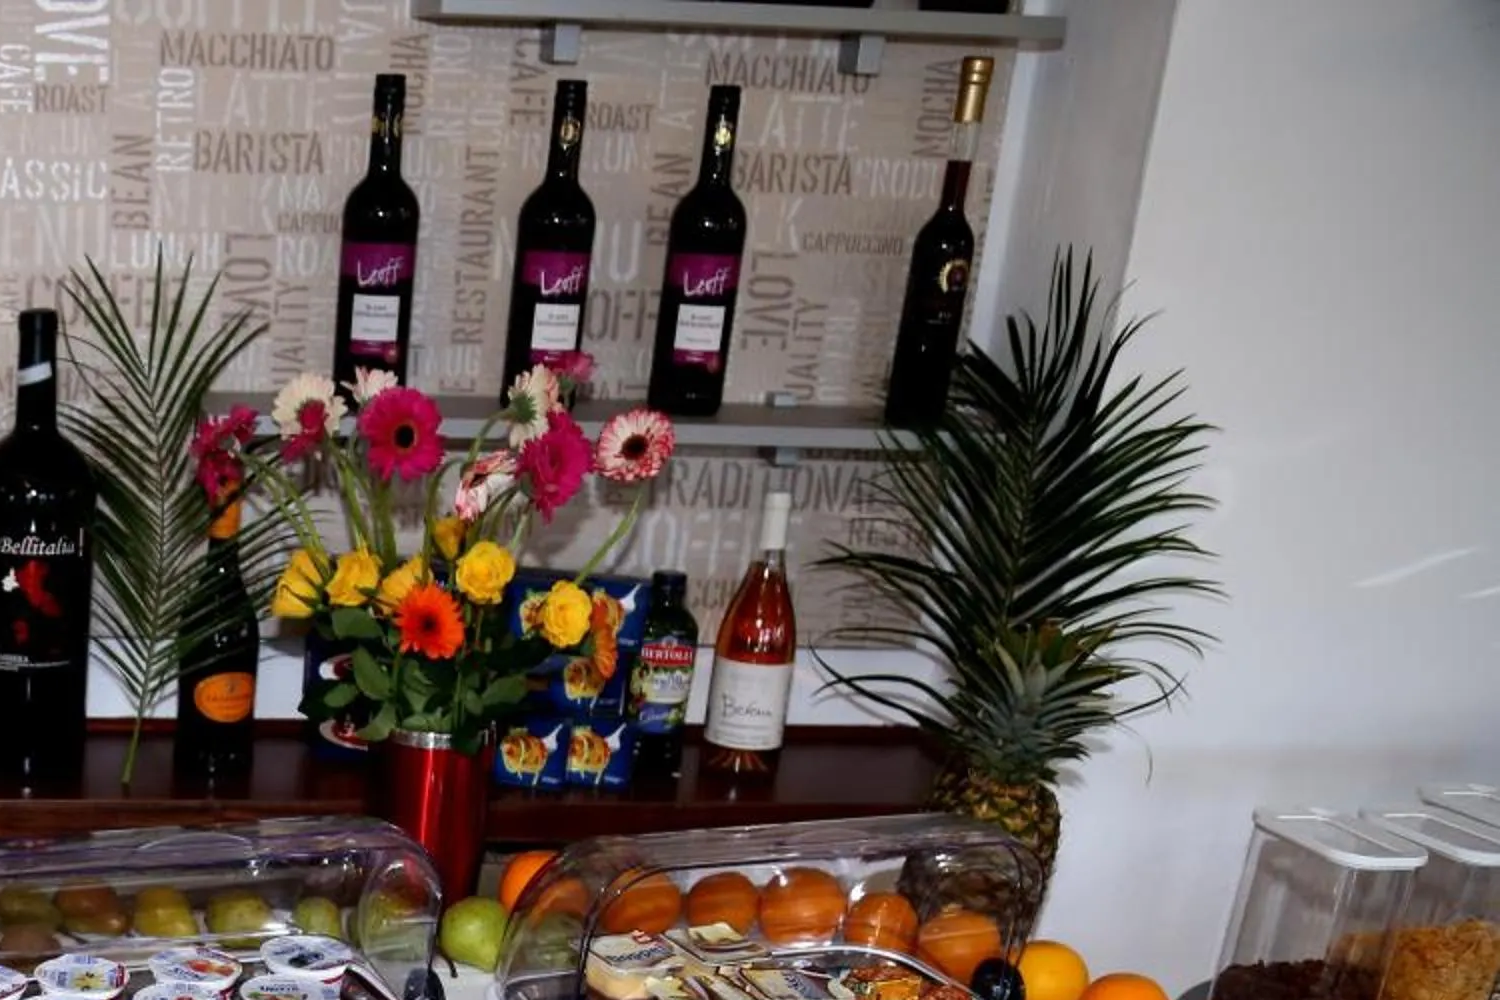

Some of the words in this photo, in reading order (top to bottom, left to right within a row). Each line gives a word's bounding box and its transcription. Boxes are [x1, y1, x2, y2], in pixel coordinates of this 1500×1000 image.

[33, 83, 111, 115] ROAST
[159, 29, 336, 72] MACCHIATO
[155, 67, 195, 173] RETRO
[192, 127, 324, 175] BARISTA
[912, 58, 961, 158] MOCHA
[109, 133, 153, 230] BEAN
[452, 144, 500, 346] RESTAURANT
[742, 252, 799, 350] LOVE
